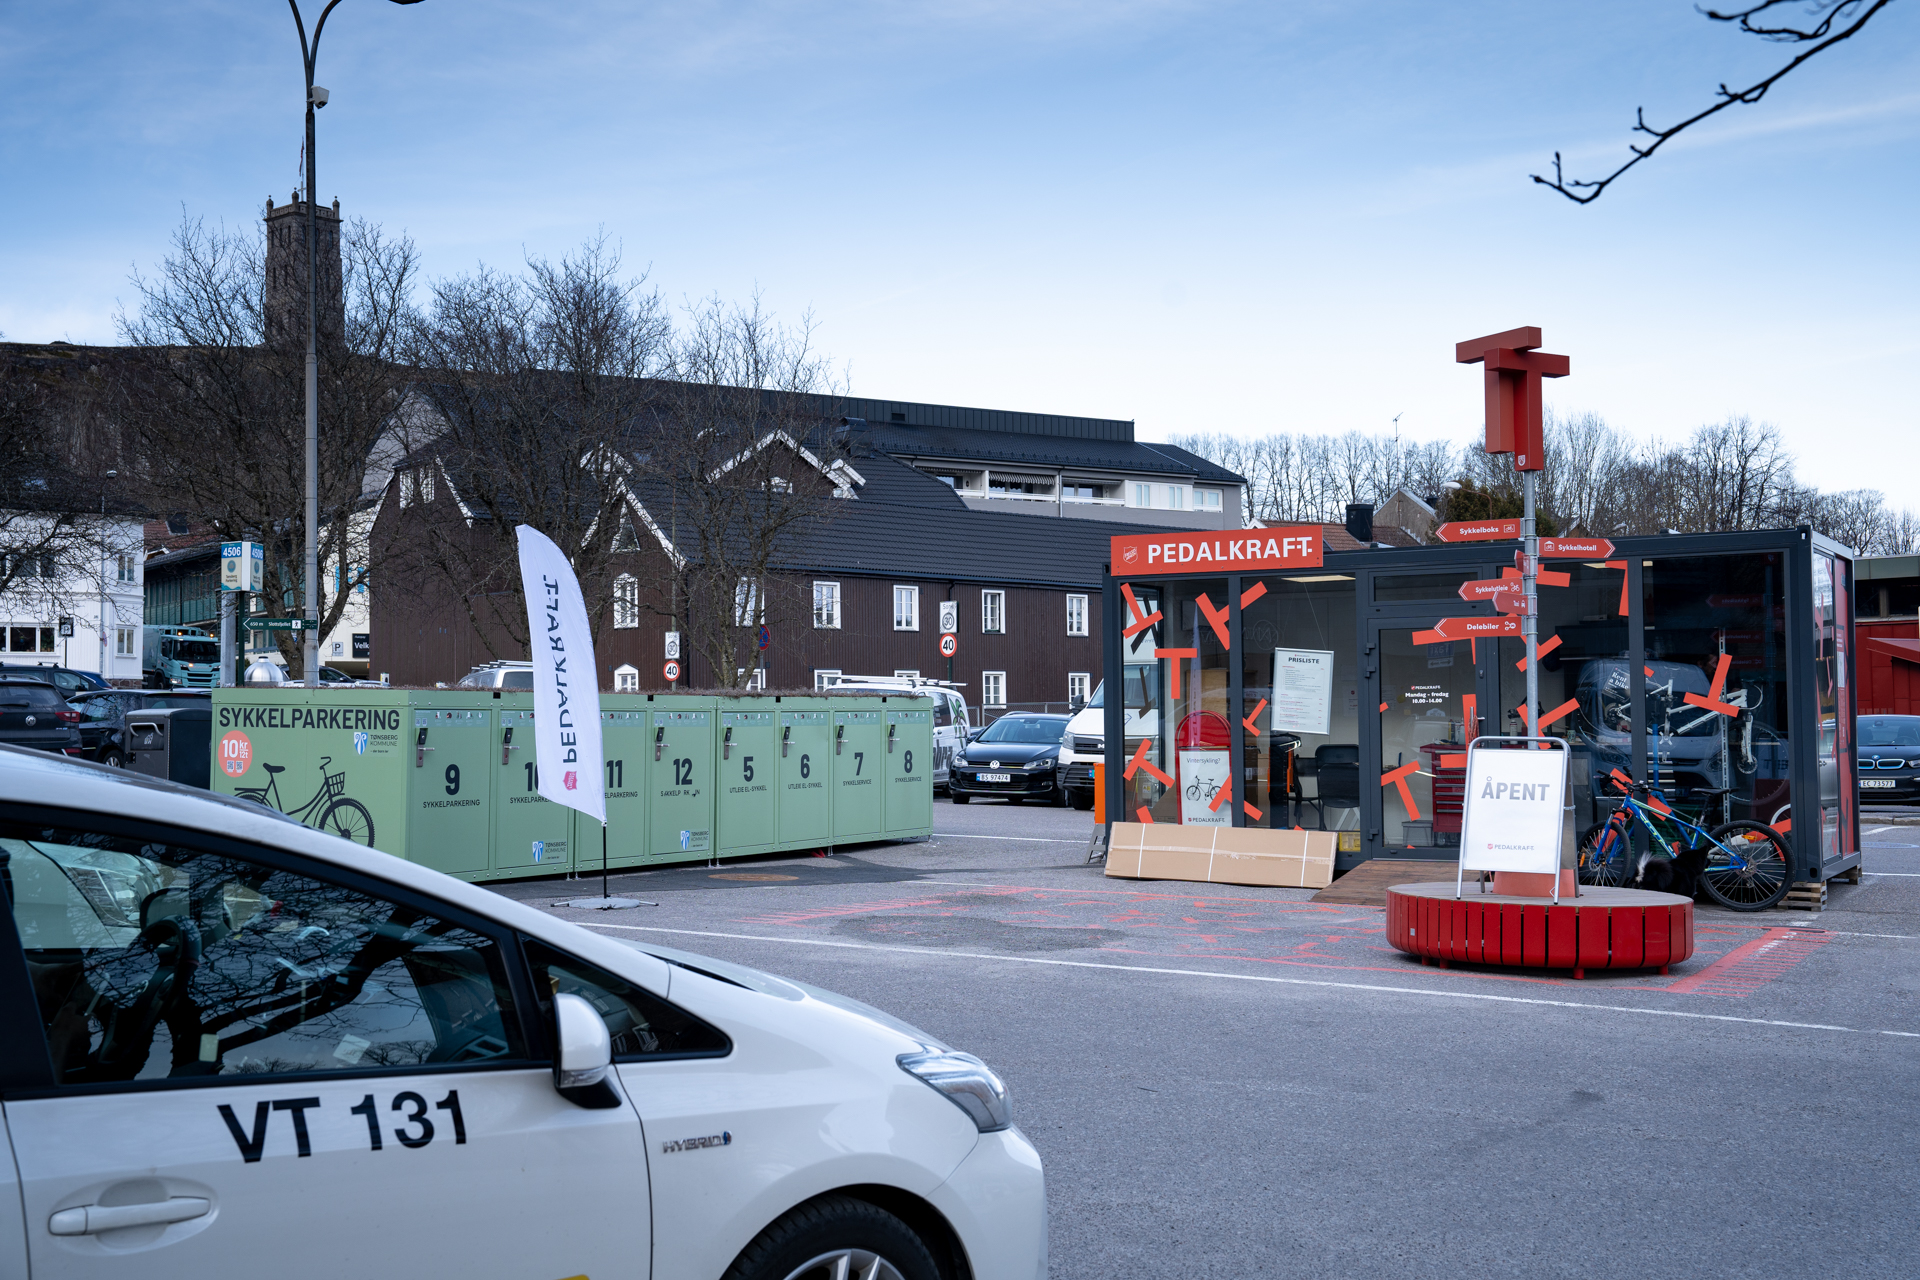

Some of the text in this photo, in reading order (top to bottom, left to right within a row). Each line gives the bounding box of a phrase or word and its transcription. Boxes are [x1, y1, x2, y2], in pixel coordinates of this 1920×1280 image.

[1460, 526, 1498, 536] Sykkelboks
[222, 546, 241, 556] 4506
[252, 548, 263, 559] 4506
[1148, 536, 1312, 564] PEDALKRAFT
[1476, 584, 1508, 593] Sykkelutleie
[334, 644, 340, 652] P
[943, 640, 954, 650] 40
[666, 666, 678, 676] 40
[219, 707, 400, 730] SYKKELPARKERING
[223, 740, 248, 758] 10 kr
[673, 758, 692, 785] 12
[743, 756, 754, 782] 5
[800, 754, 810, 778] 6
[854, 752, 864, 776] 7
[904, 750, 913, 773] 8
[445, 764, 460, 795] 9
[606, 760, 622, 788] 11
[1481, 776, 1550, 801] ÅPENT
[423, 799, 480, 808] SYKKELPARKERING
[217, 1089, 466, 1162] VT 131
[663, 1135, 722, 1153] HYBRID
